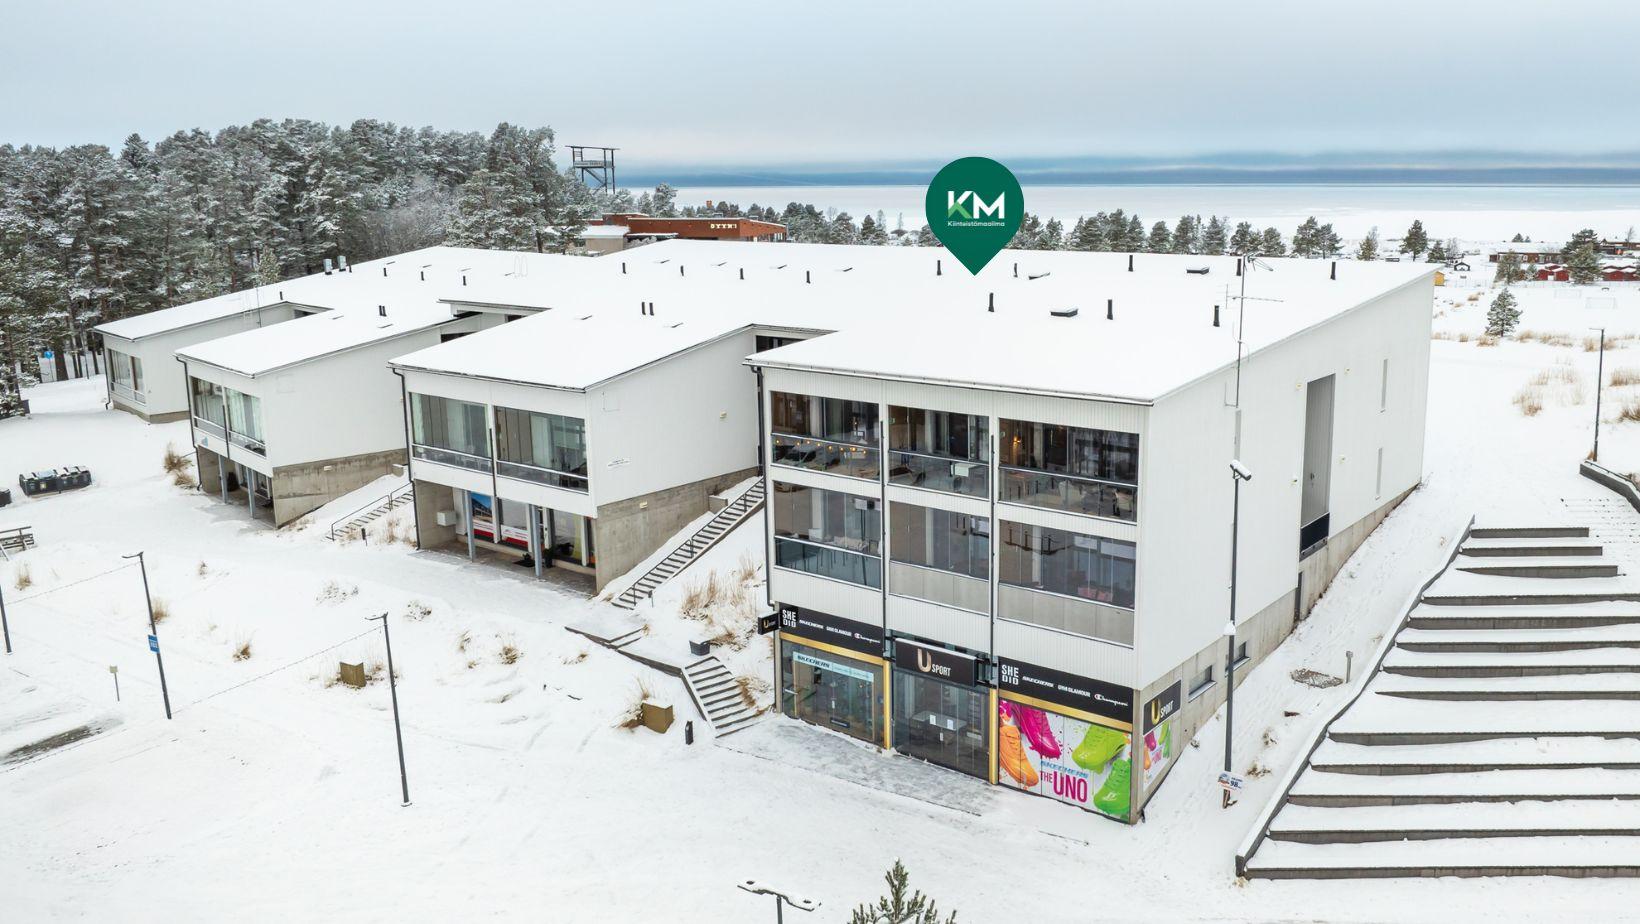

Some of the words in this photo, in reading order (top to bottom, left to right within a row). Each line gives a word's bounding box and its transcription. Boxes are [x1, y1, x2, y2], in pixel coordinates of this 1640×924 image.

[782, 609, 797, 621] SHE
[931, 663, 952, 677] SPORT
[1001, 664, 1019, 678] SHE
[1001, 675, 1019, 686] DID
[1094, 693, 1128, 707] Champion
[1160, 700, 1174, 719] SPORT
[1040, 770, 1053, 783] THE
[1053, 770, 1088, 803] UNO
